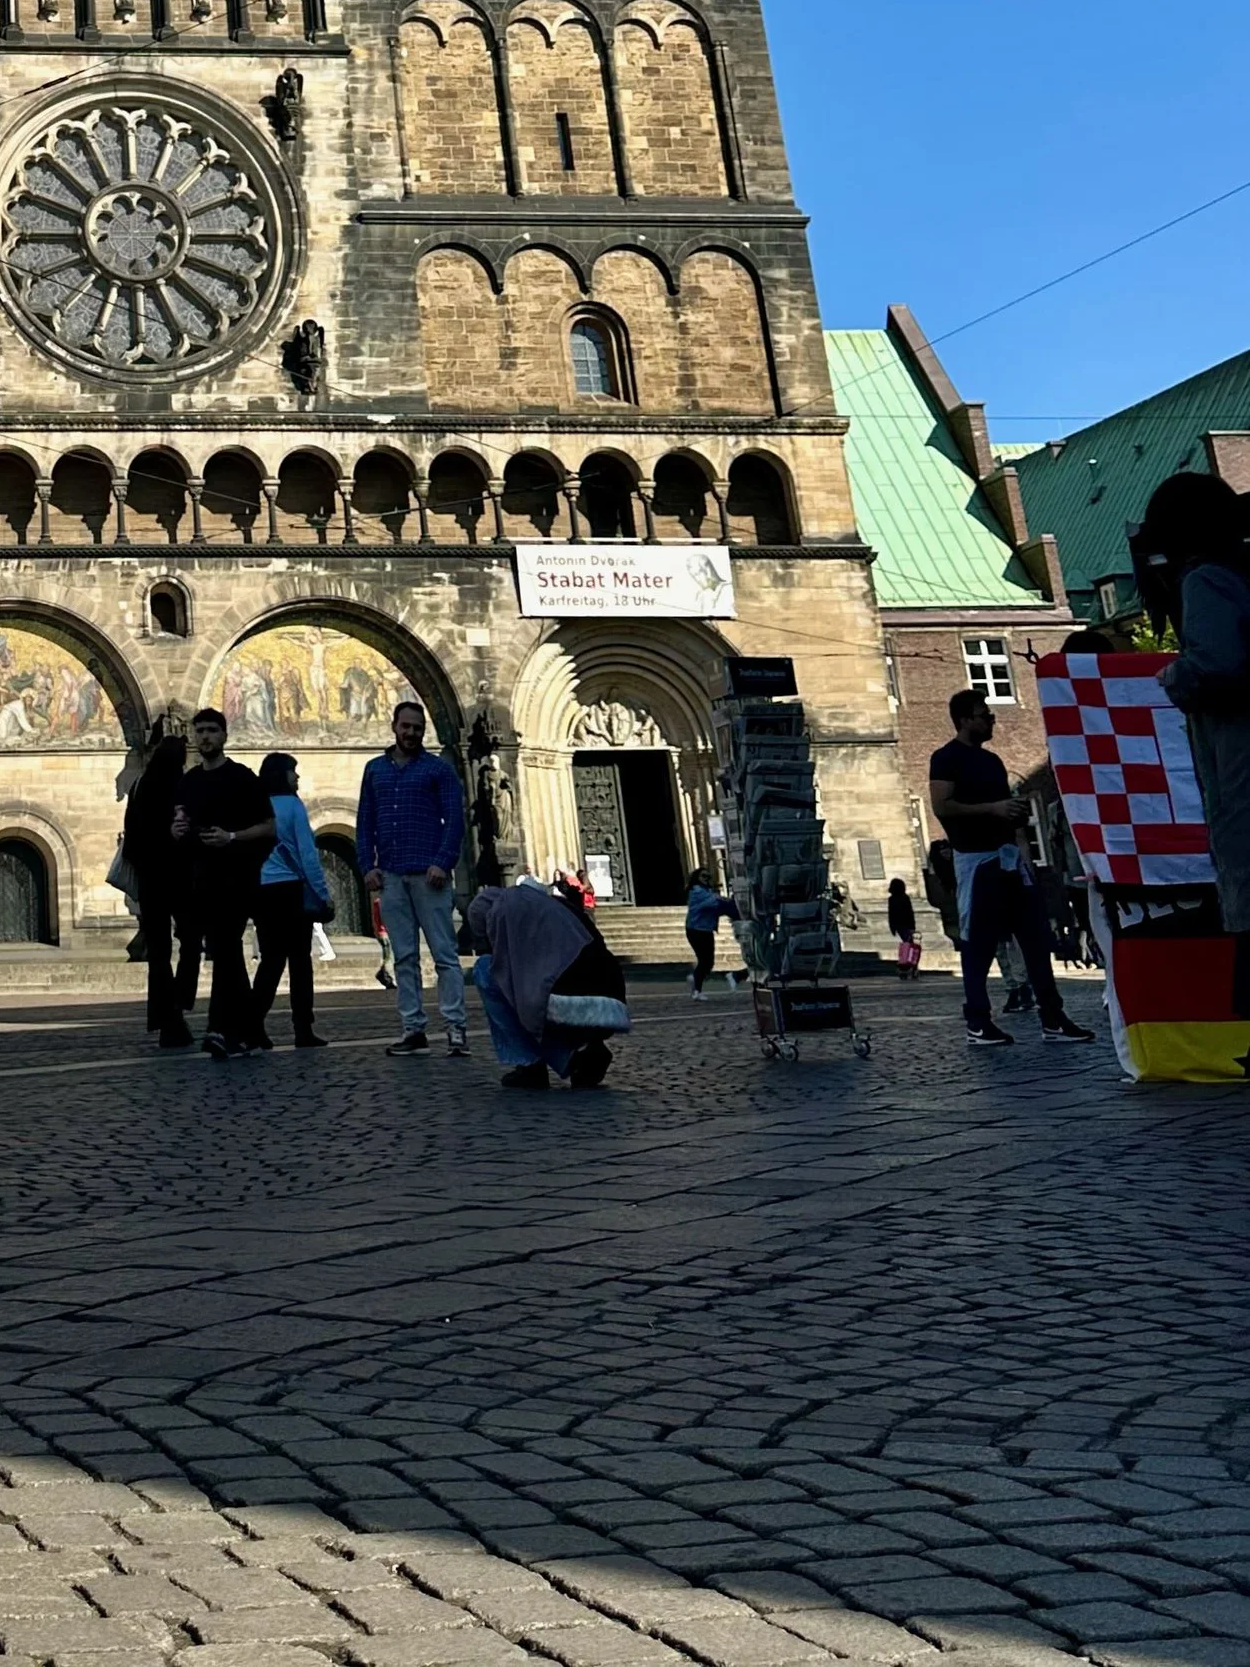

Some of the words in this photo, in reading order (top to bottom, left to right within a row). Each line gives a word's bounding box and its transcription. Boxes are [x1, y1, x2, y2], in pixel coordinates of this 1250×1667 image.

[537, 571, 605, 588] Stabat
[613, 572, 673, 588] Mater
[539, 595, 609, 608] Karfreitag,
[614, 595, 629, 606] 18
[633, 596, 656, 607] Uhr
